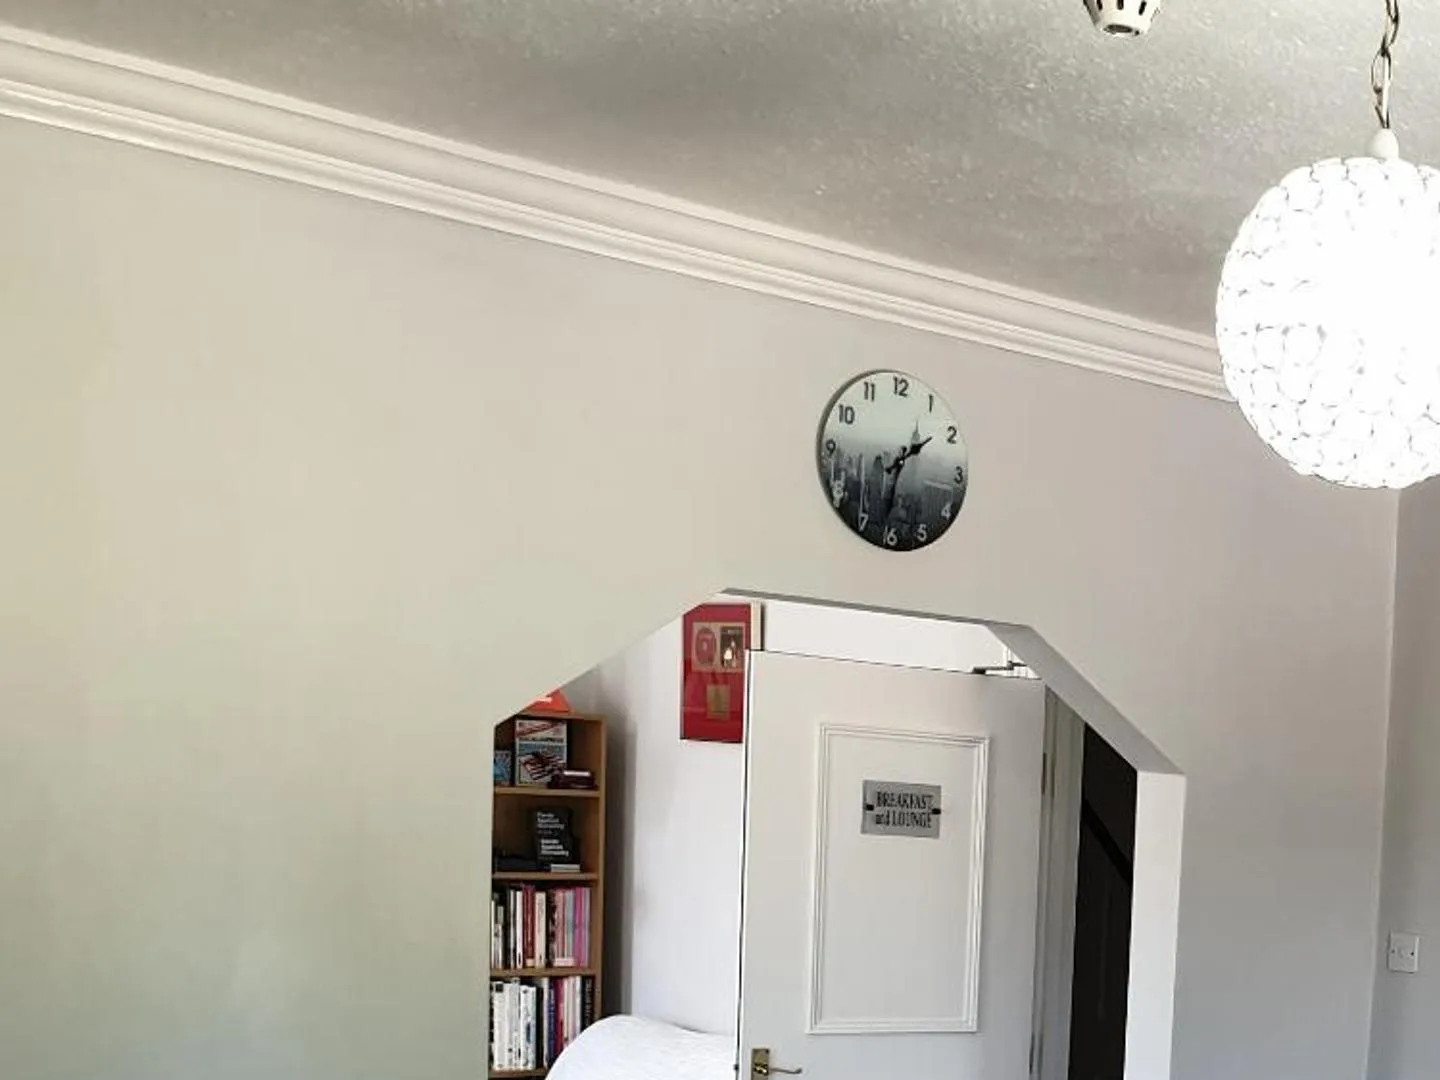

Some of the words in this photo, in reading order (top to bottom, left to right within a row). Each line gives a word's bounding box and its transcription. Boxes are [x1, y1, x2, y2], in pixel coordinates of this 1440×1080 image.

[863, 381, 876, 402] 11
[893, 376, 910, 397] 12
[928, 394, 934, 413] 1
[838, 403, 856, 425] 10
[946, 426, 958, 445] 2
[825, 439, 837, 457] 9
[954, 466, 964, 484] 3
[941, 502, 951, 521] 4
[917, 524, 928, 542] 5
[876, 791, 935, 810] BREAKFAST
